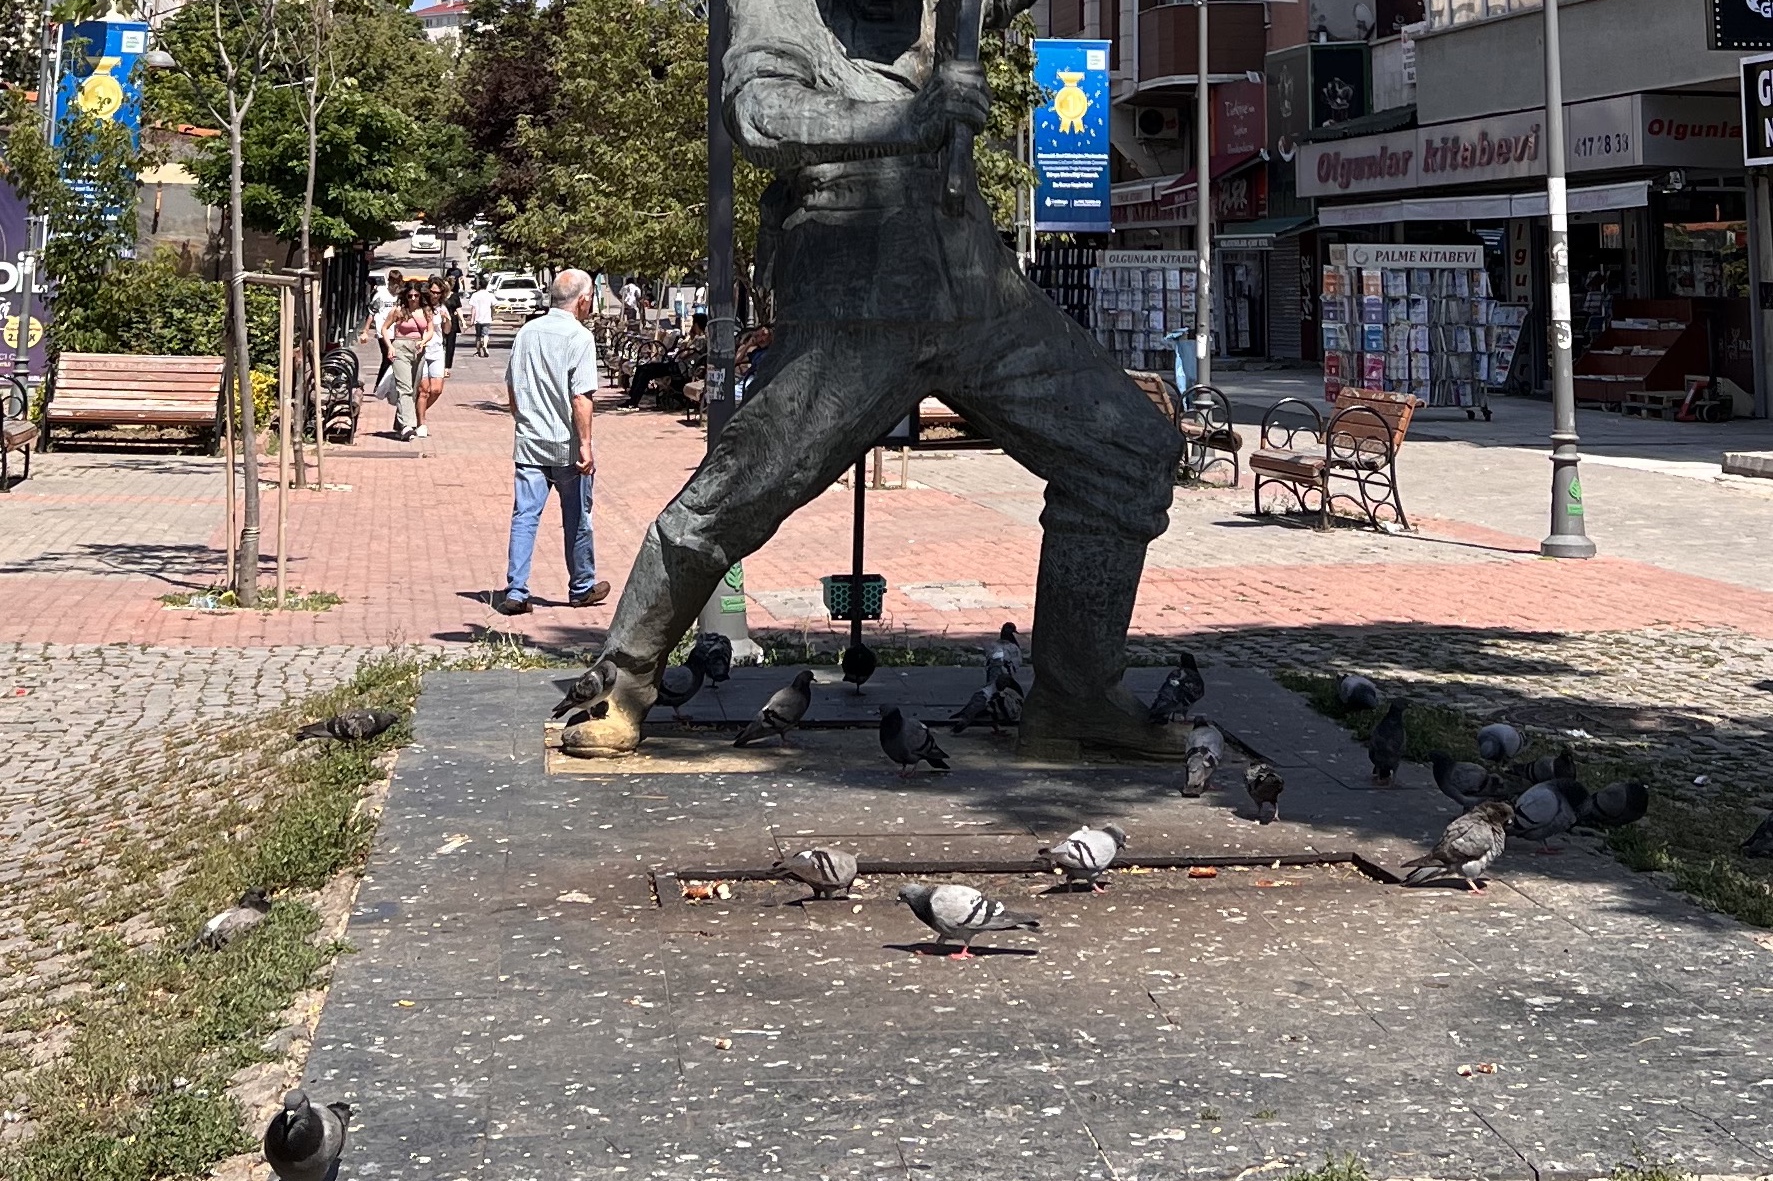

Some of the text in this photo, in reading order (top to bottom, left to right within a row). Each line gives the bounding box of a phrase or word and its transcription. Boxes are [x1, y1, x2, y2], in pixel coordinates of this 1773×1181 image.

[1317, 145, 1413, 189] Olgunlar
[1108, 253, 1159, 265] OLGUNLAR
[1374, 247, 1478, 263] PALME KİTABEVİ
